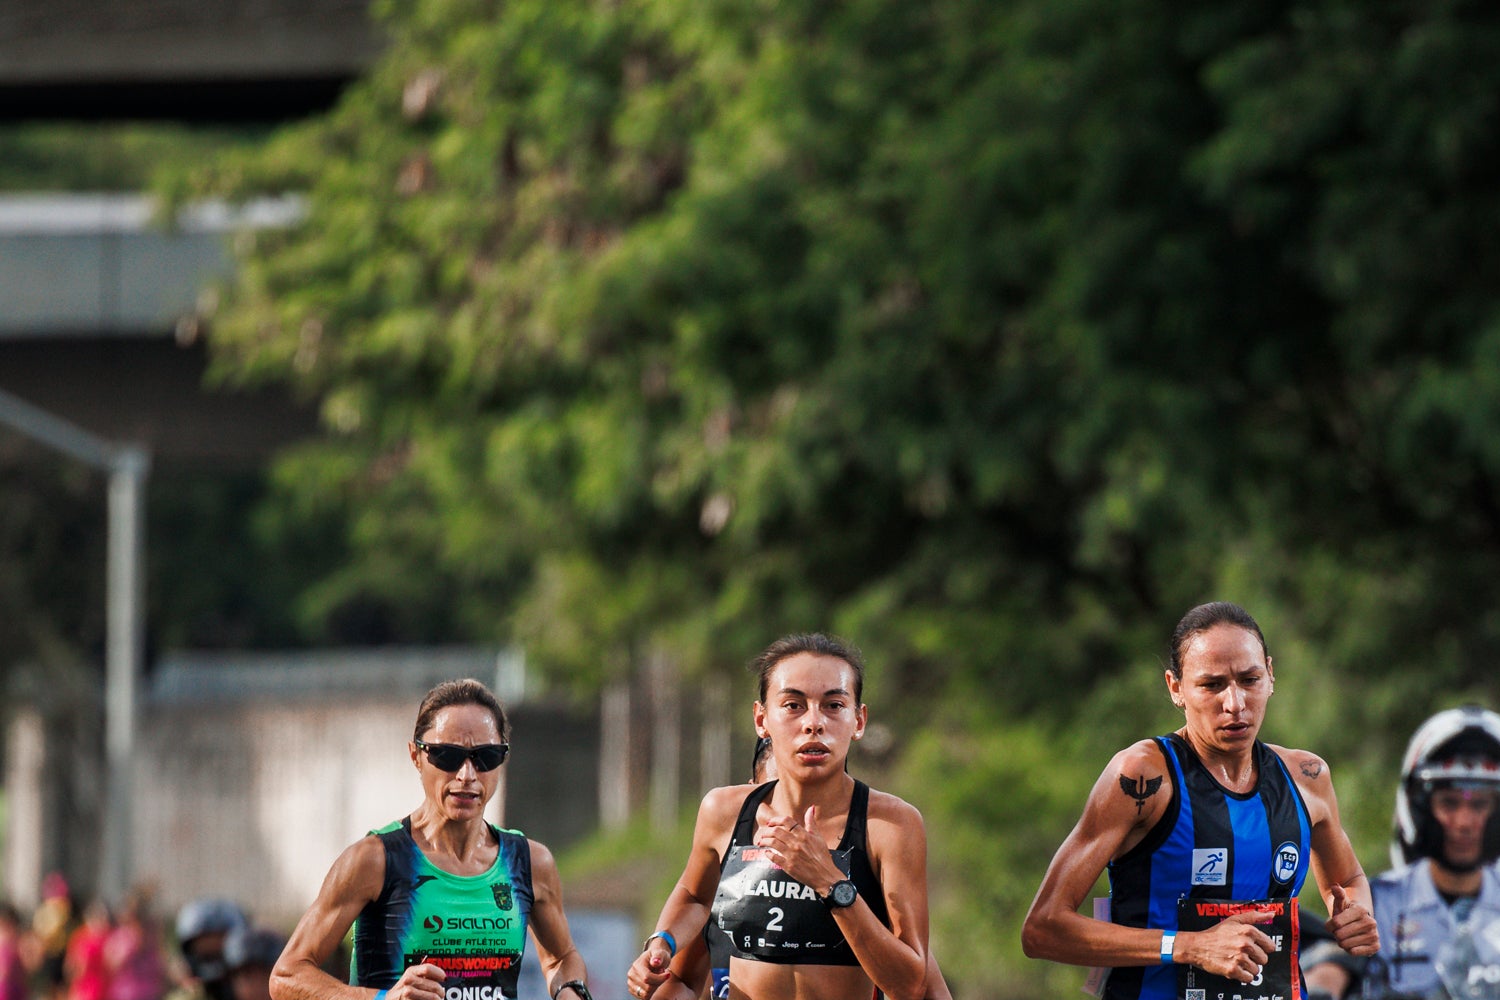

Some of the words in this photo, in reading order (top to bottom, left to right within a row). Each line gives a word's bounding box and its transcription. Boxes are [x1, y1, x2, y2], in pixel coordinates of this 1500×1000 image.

[744, 880, 816, 900] LAURA
[766, 907, 784, 931] 2
[432, 938, 462, 946] CLUBE
[465, 937, 507, 946] ATLÉTICO
[782, 941, 799, 949] Jeep
